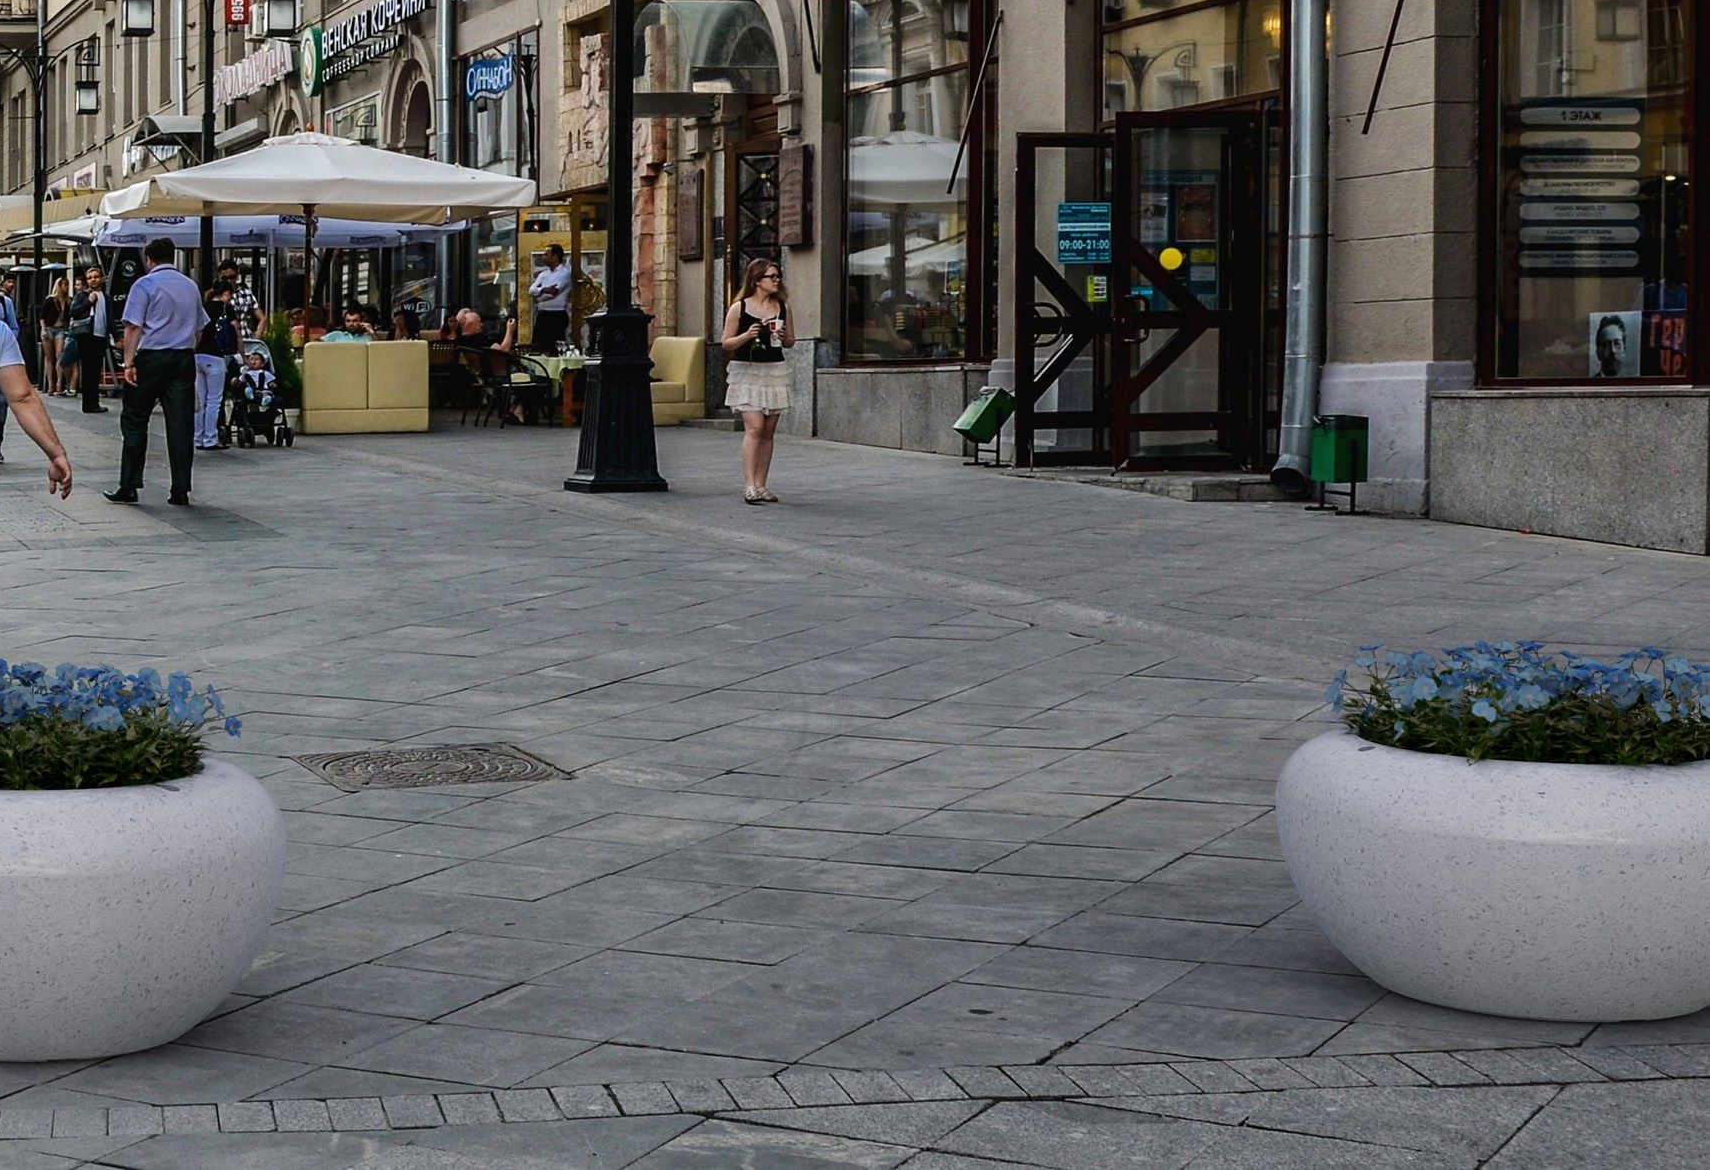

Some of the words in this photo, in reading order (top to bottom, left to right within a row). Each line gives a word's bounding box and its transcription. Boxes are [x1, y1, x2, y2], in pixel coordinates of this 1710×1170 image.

[322, 9, 368, 61] ВЕНСКАЯ
[322, 50, 365, 83] COFFEESHOP
[366, 33, 401, 61] COMPANY
[1561, 111, 1567, 121] 1
[1569, 111, 1602, 121] ЭТАЖ
[1059, 240, 1110, 250] 09:00-21:00
